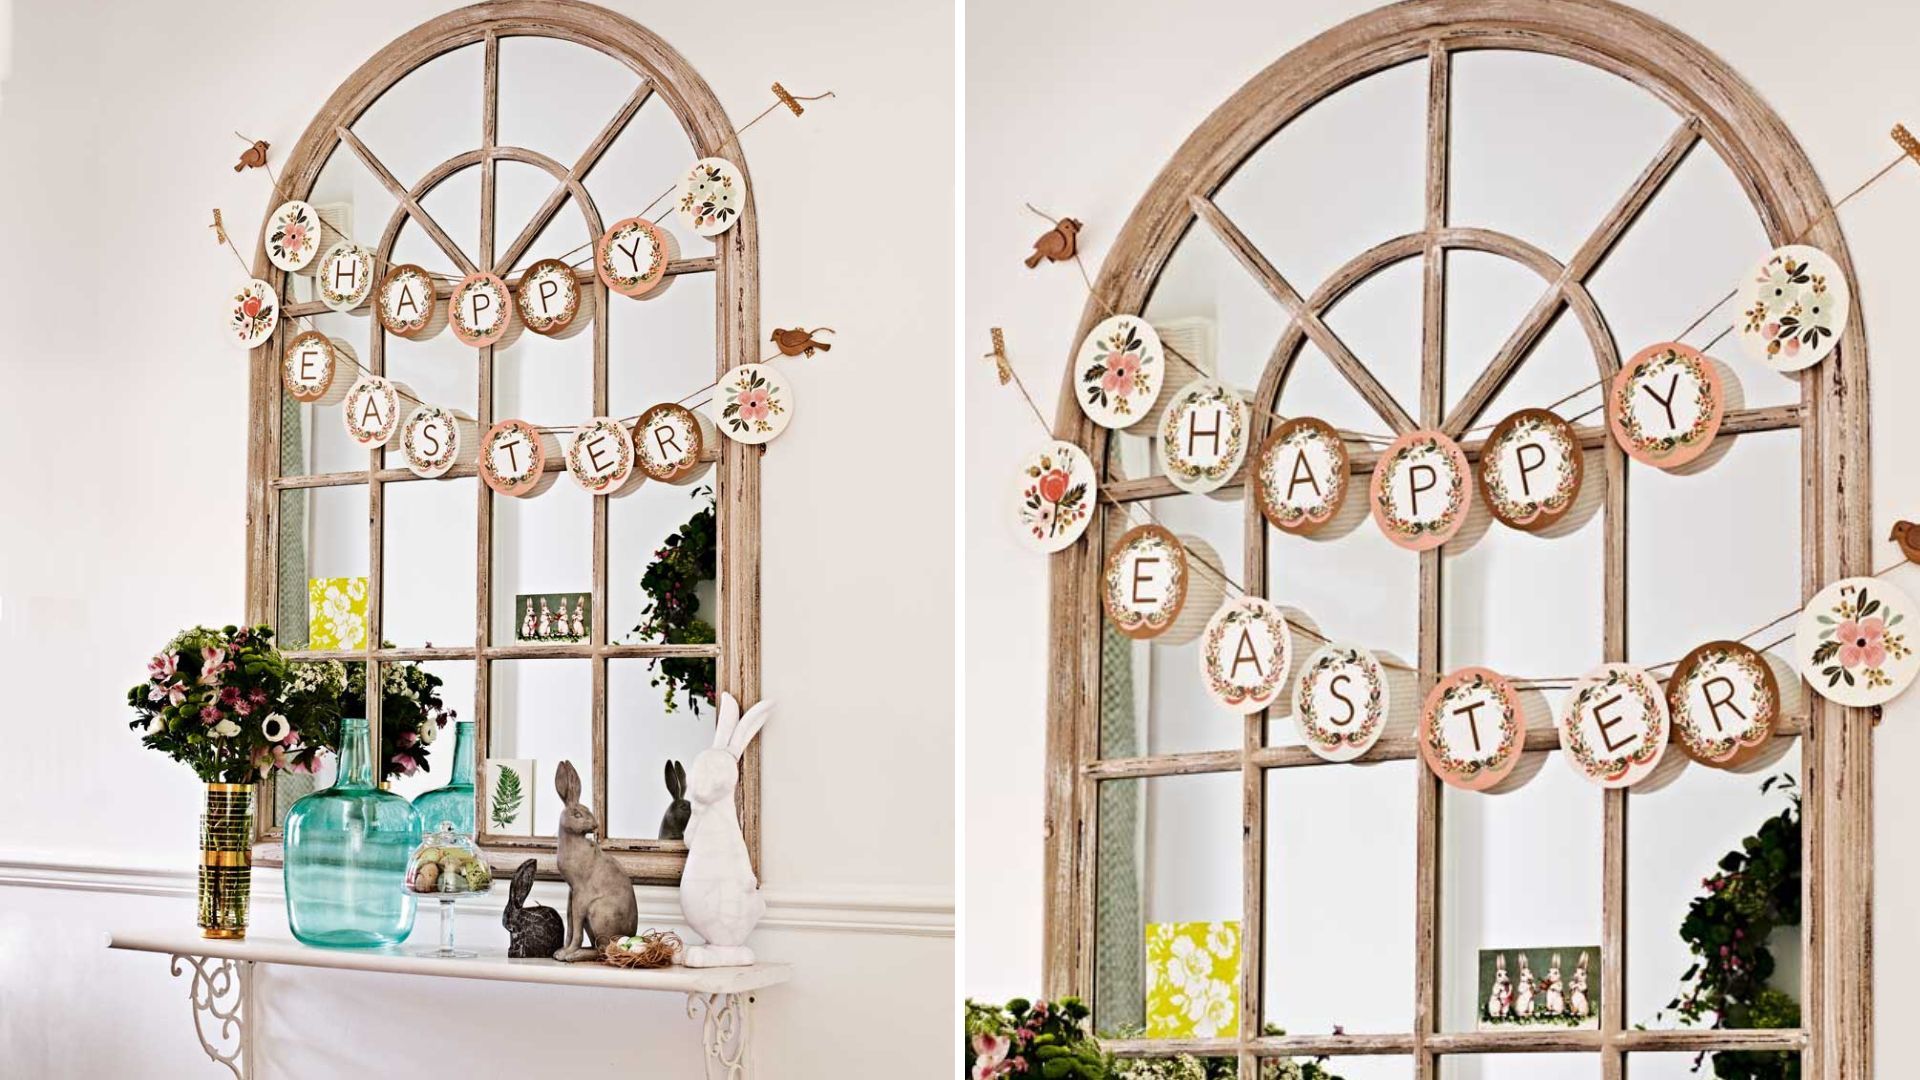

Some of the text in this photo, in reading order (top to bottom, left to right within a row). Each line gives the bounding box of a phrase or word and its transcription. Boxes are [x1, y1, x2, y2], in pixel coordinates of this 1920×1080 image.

[334, 237, 641, 326] HAPPY
[300, 351, 683, 473] EASTER
[1188, 373, 1682, 516] HAPPY
[1132, 557, 1747, 754] EASTER
